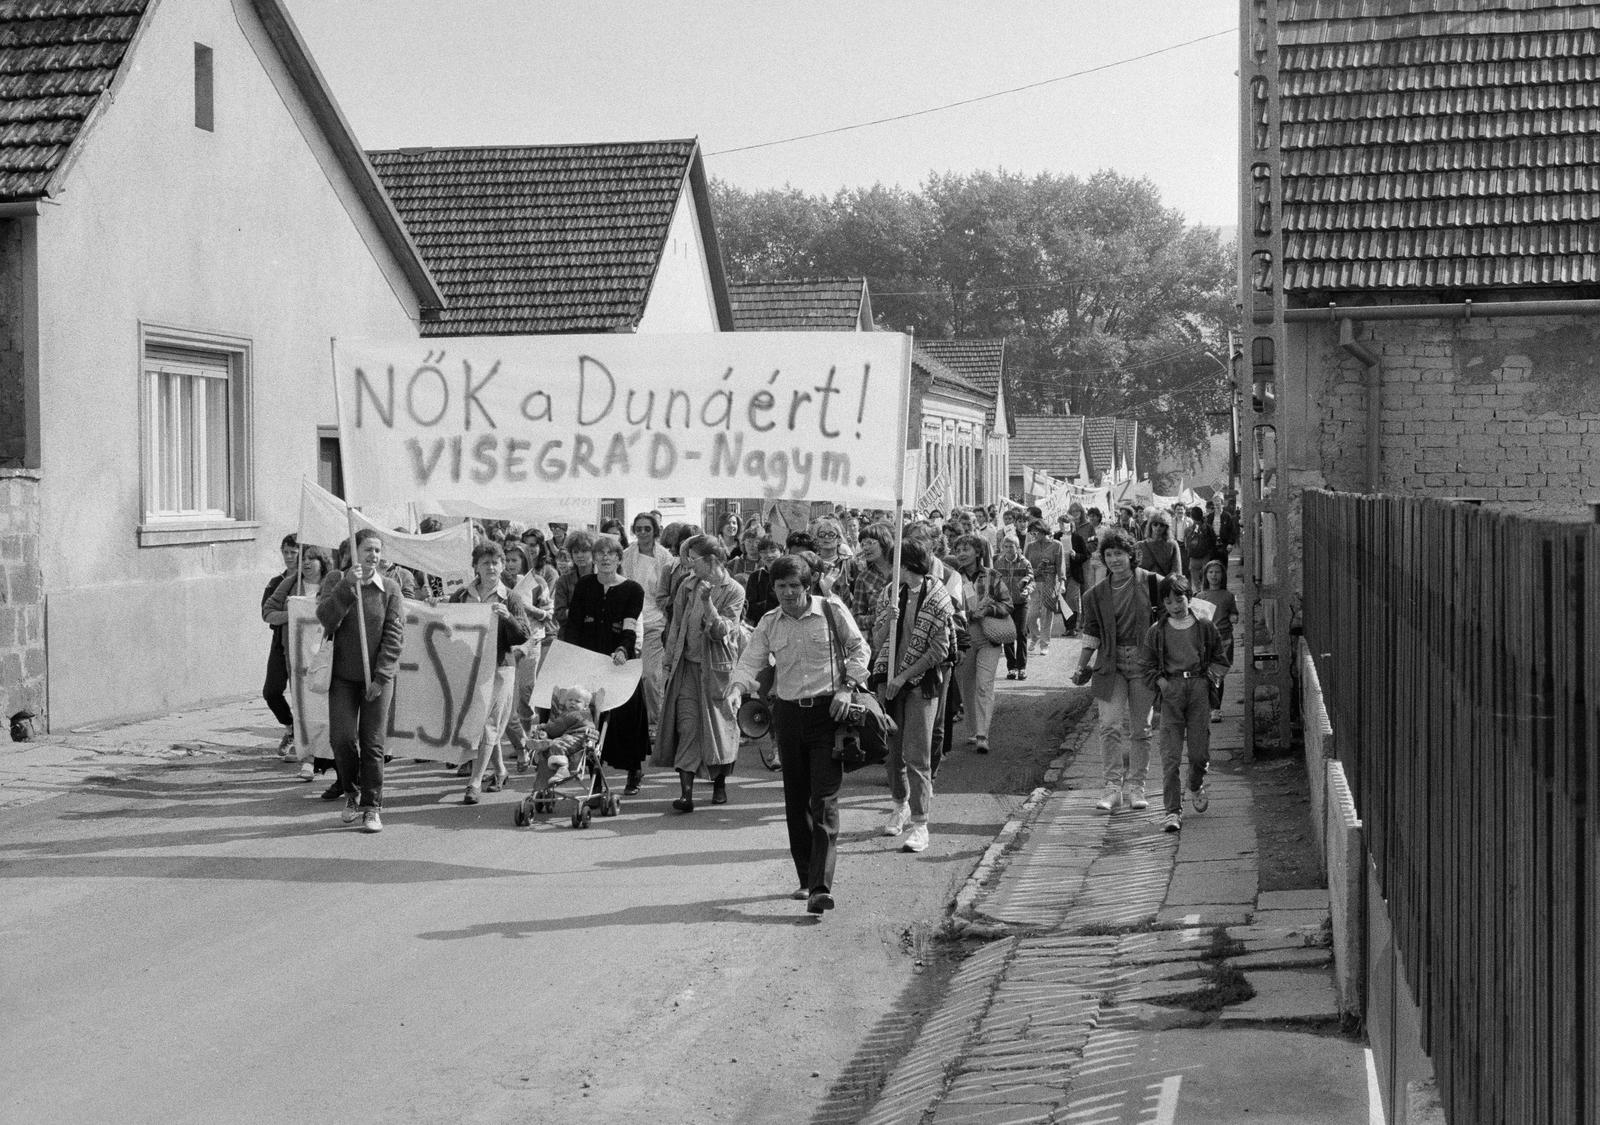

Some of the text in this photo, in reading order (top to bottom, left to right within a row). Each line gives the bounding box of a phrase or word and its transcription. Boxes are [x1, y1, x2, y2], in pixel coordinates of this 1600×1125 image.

[354, 350, 871, 439] NŐK a Dunáért!
